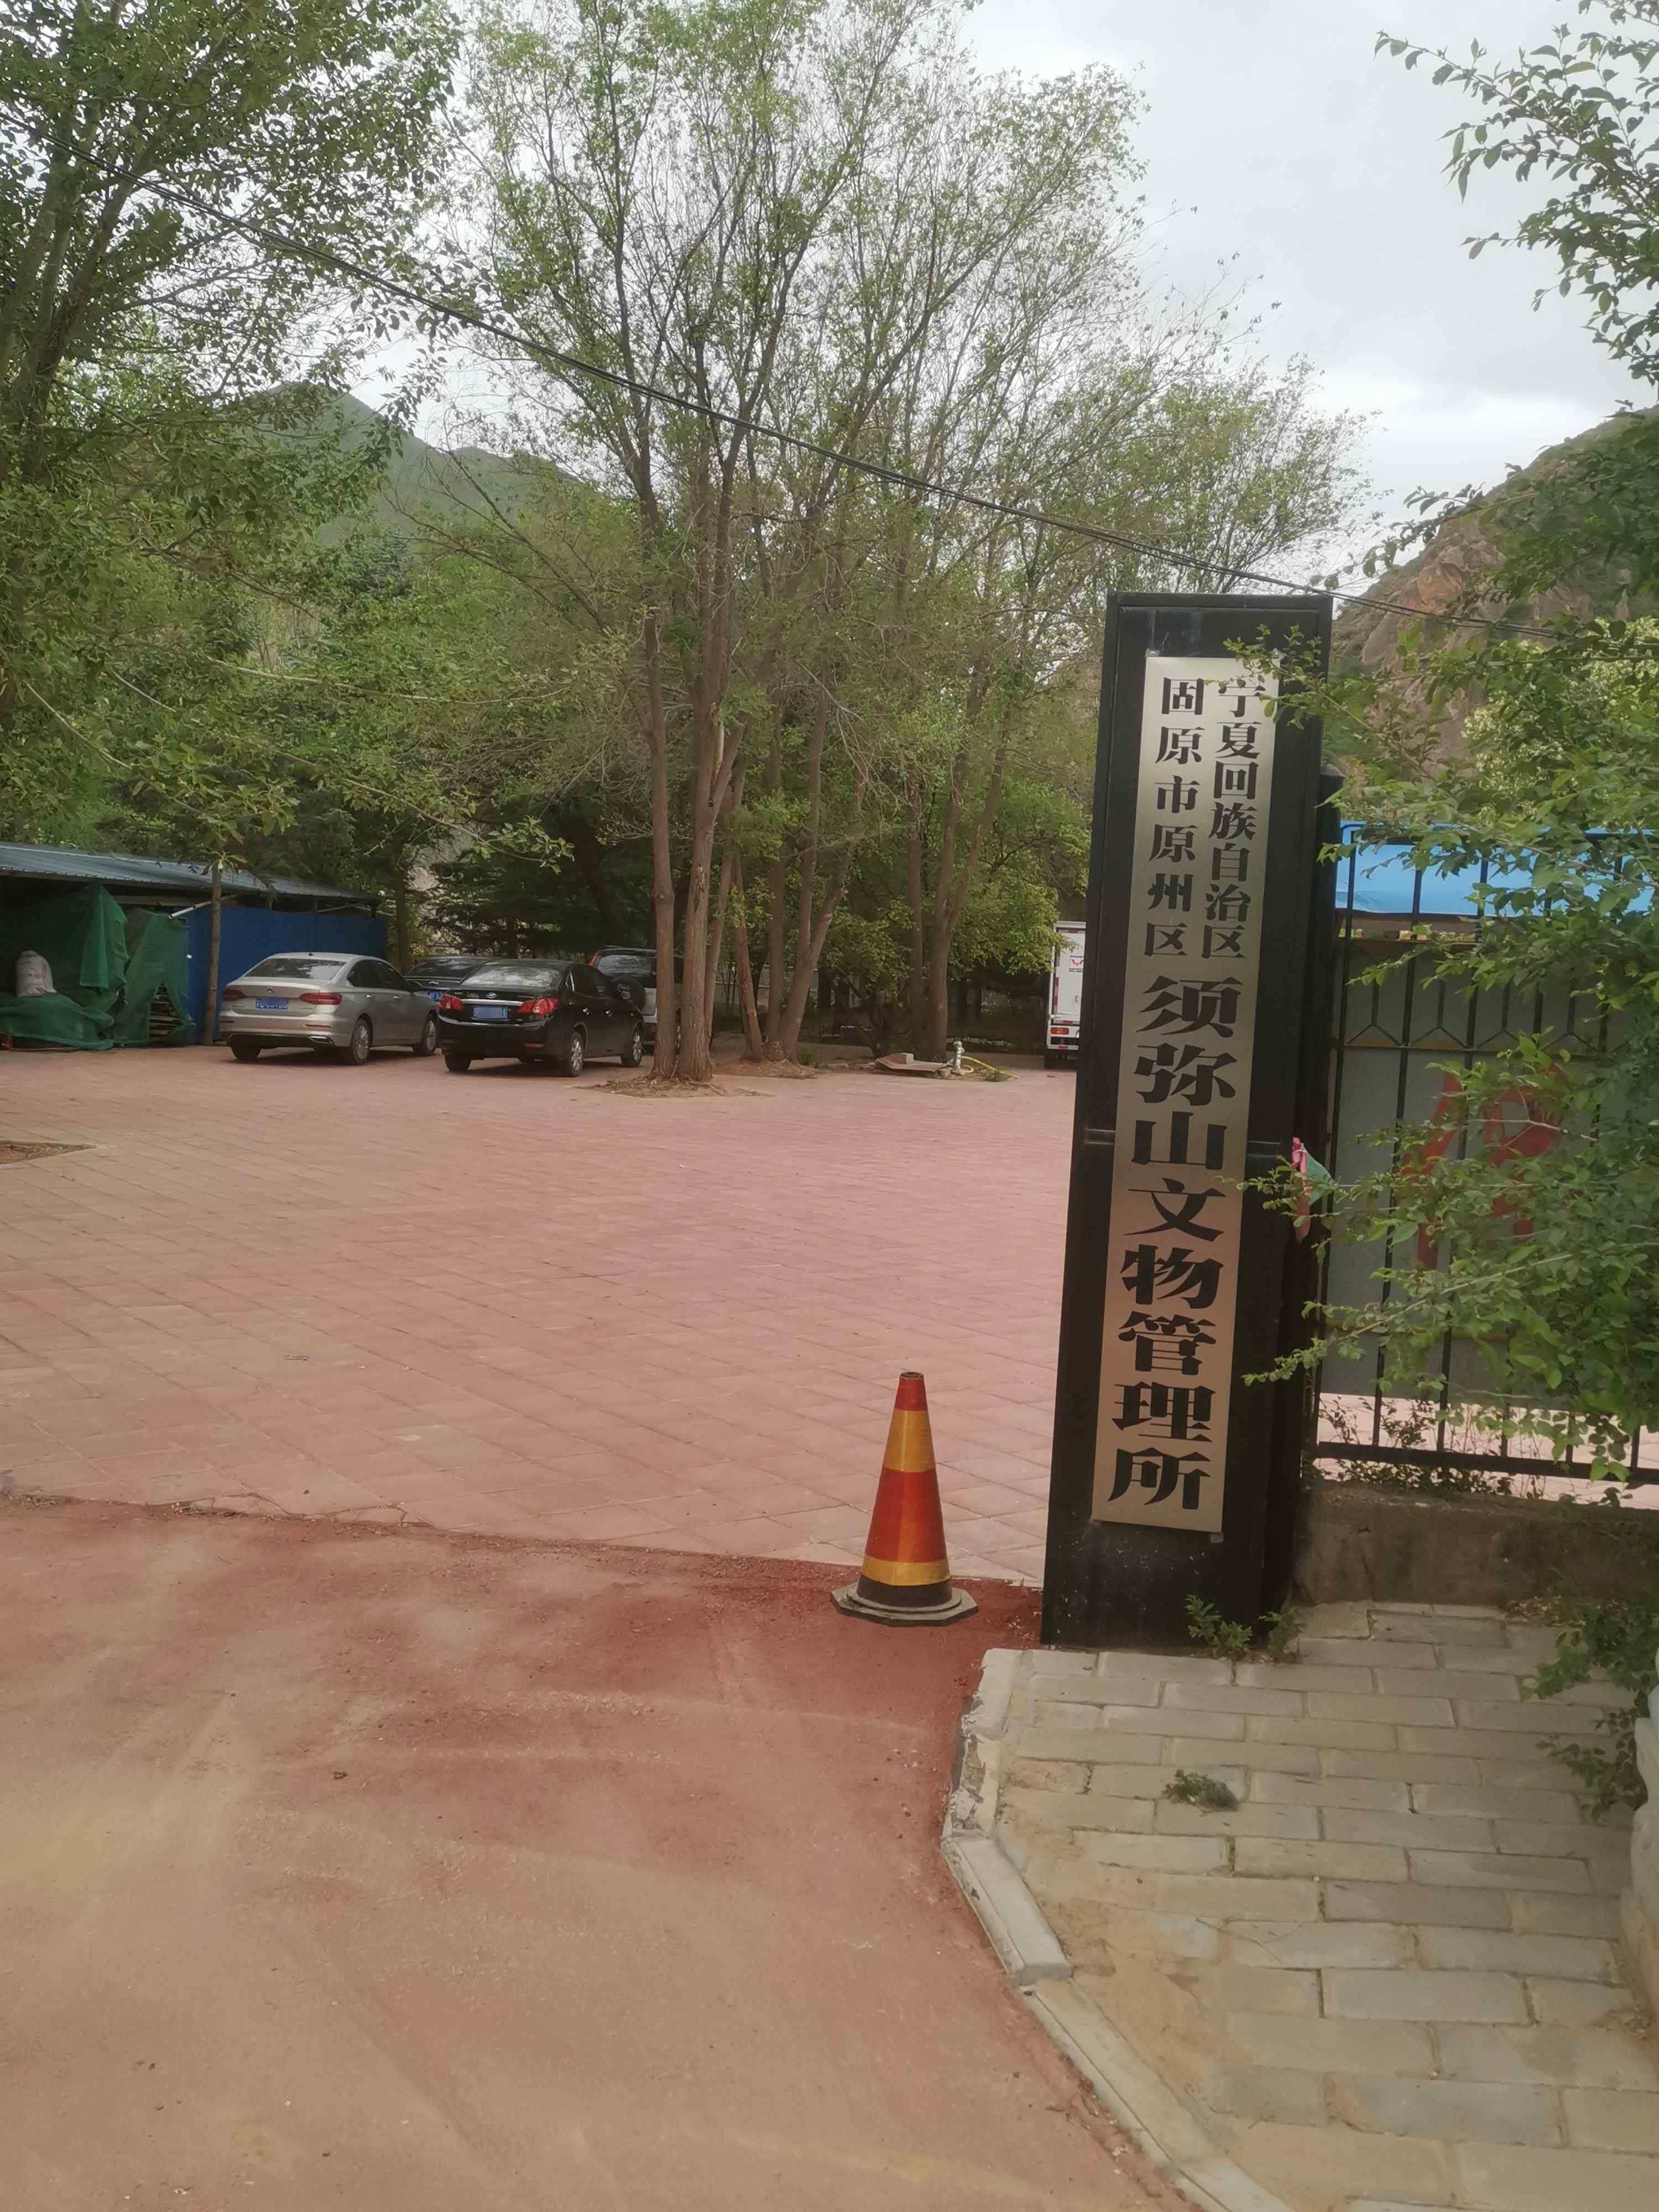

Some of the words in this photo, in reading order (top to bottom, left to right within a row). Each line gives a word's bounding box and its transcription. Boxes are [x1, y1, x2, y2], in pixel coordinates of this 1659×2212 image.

[1144, 677, 1204, 957] 固原市原州区
[1201, 679, 1265, 959] 宁夏回族自治区
[1107, 975, 1243, 1510] 须弥山文物管理所
